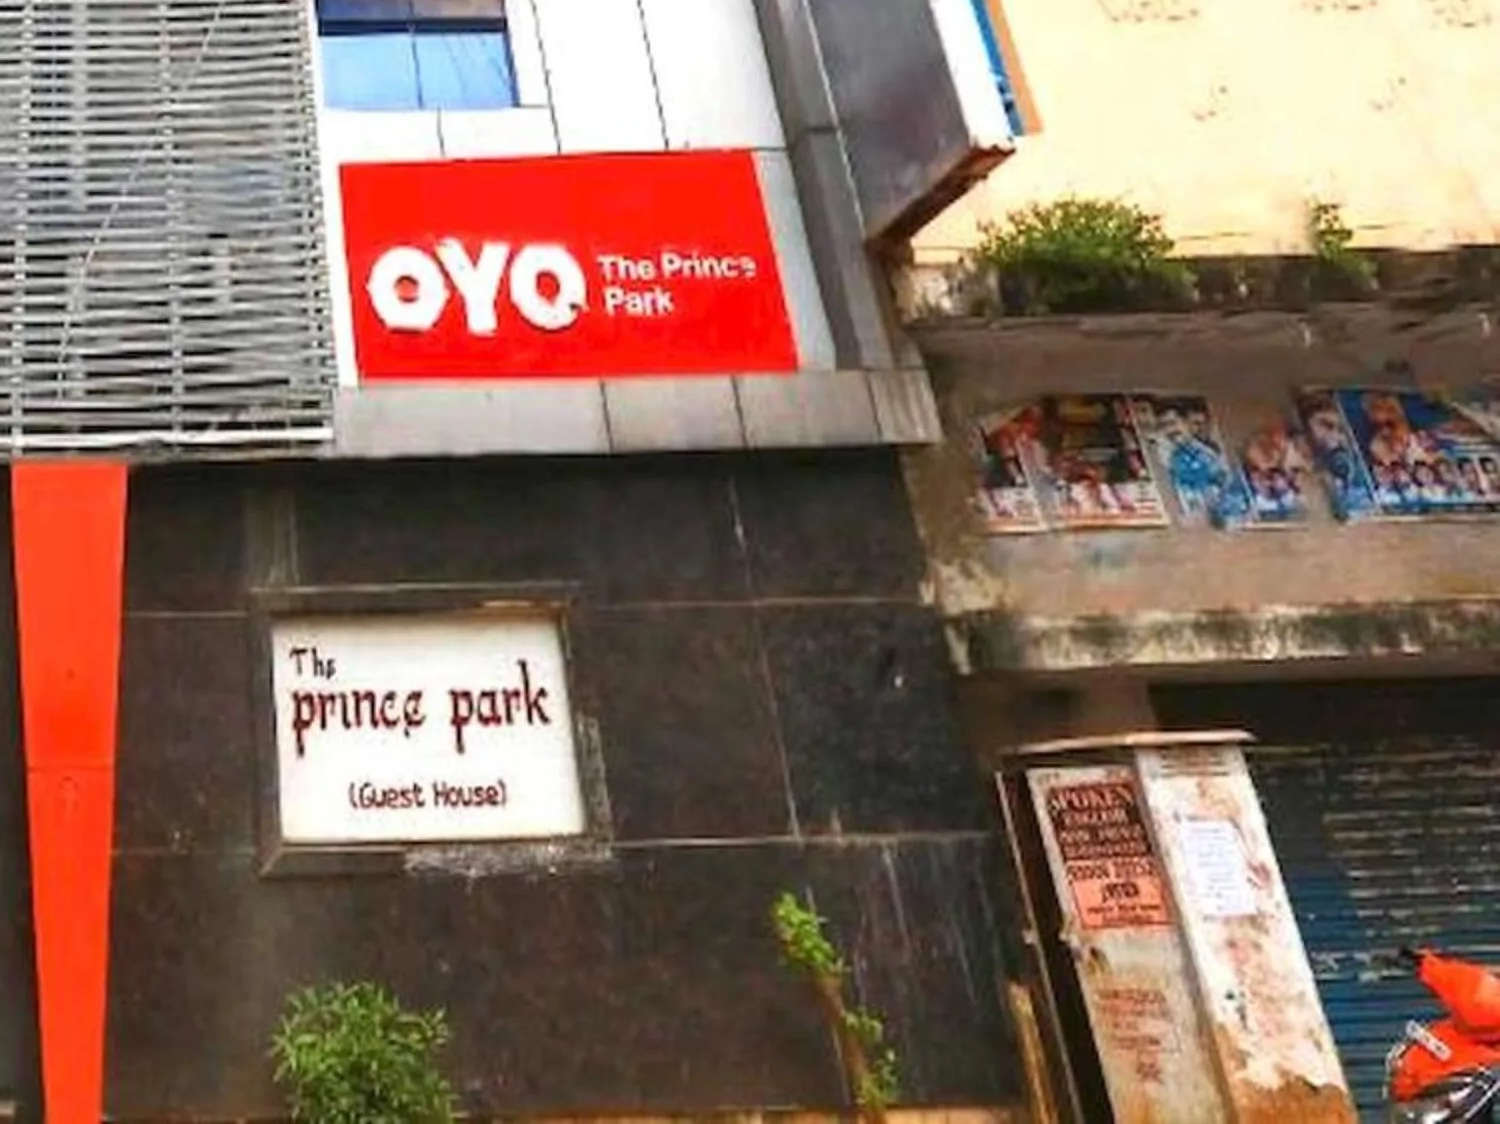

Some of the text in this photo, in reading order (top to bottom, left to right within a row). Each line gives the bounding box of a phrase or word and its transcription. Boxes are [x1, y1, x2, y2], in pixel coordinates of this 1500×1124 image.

[598, 251, 756, 280] The Prince
[367, 237, 588, 336] OYO
[605, 287, 675, 317] Park
[291, 659, 552, 759] prince park
[349, 777, 507, 809] (Guest House)
